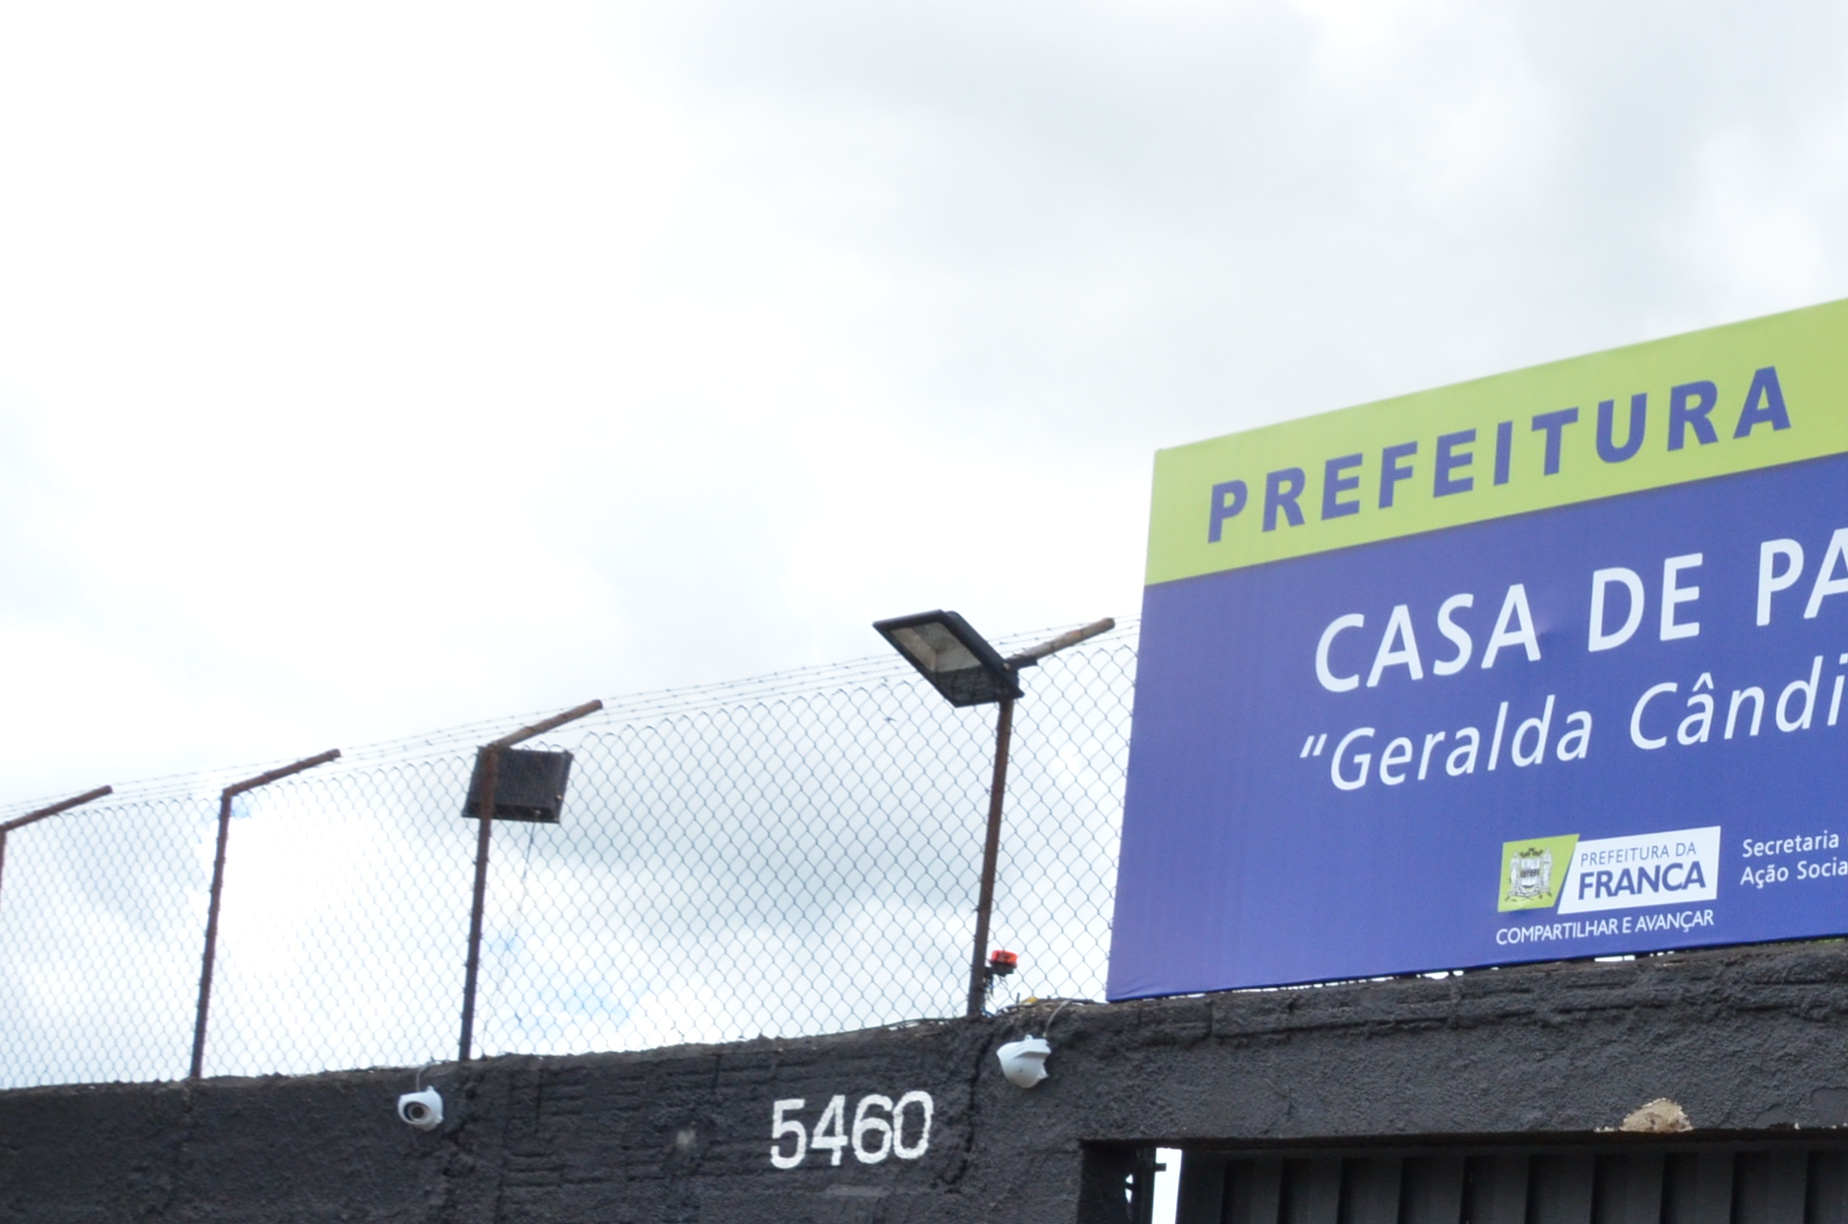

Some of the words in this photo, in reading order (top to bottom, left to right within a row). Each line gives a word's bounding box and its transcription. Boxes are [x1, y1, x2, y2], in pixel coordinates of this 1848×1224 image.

[1207, 366, 1791, 543] PREFEITURA
[1313, 583, 1542, 693] CASA
[1587, 552, 1704, 653] DE
[1298, 694, 1592, 791] “Geralda
[1580, 843, 1670, 867] PREFEITURA
[1674, 841, 1697, 858] DA
[1742, 830, 1840, 858] Secretaria
[1577, 860, 1707, 901] FRANCA
[1740, 863, 1789, 889] Ação
[1495, 917, 1619, 946] COMPARTILHAR
[1621, 916, 1633, 934] E
[1634, 908, 1715, 933] AVANÇAR
[769, 1090, 935, 1170] 5460
